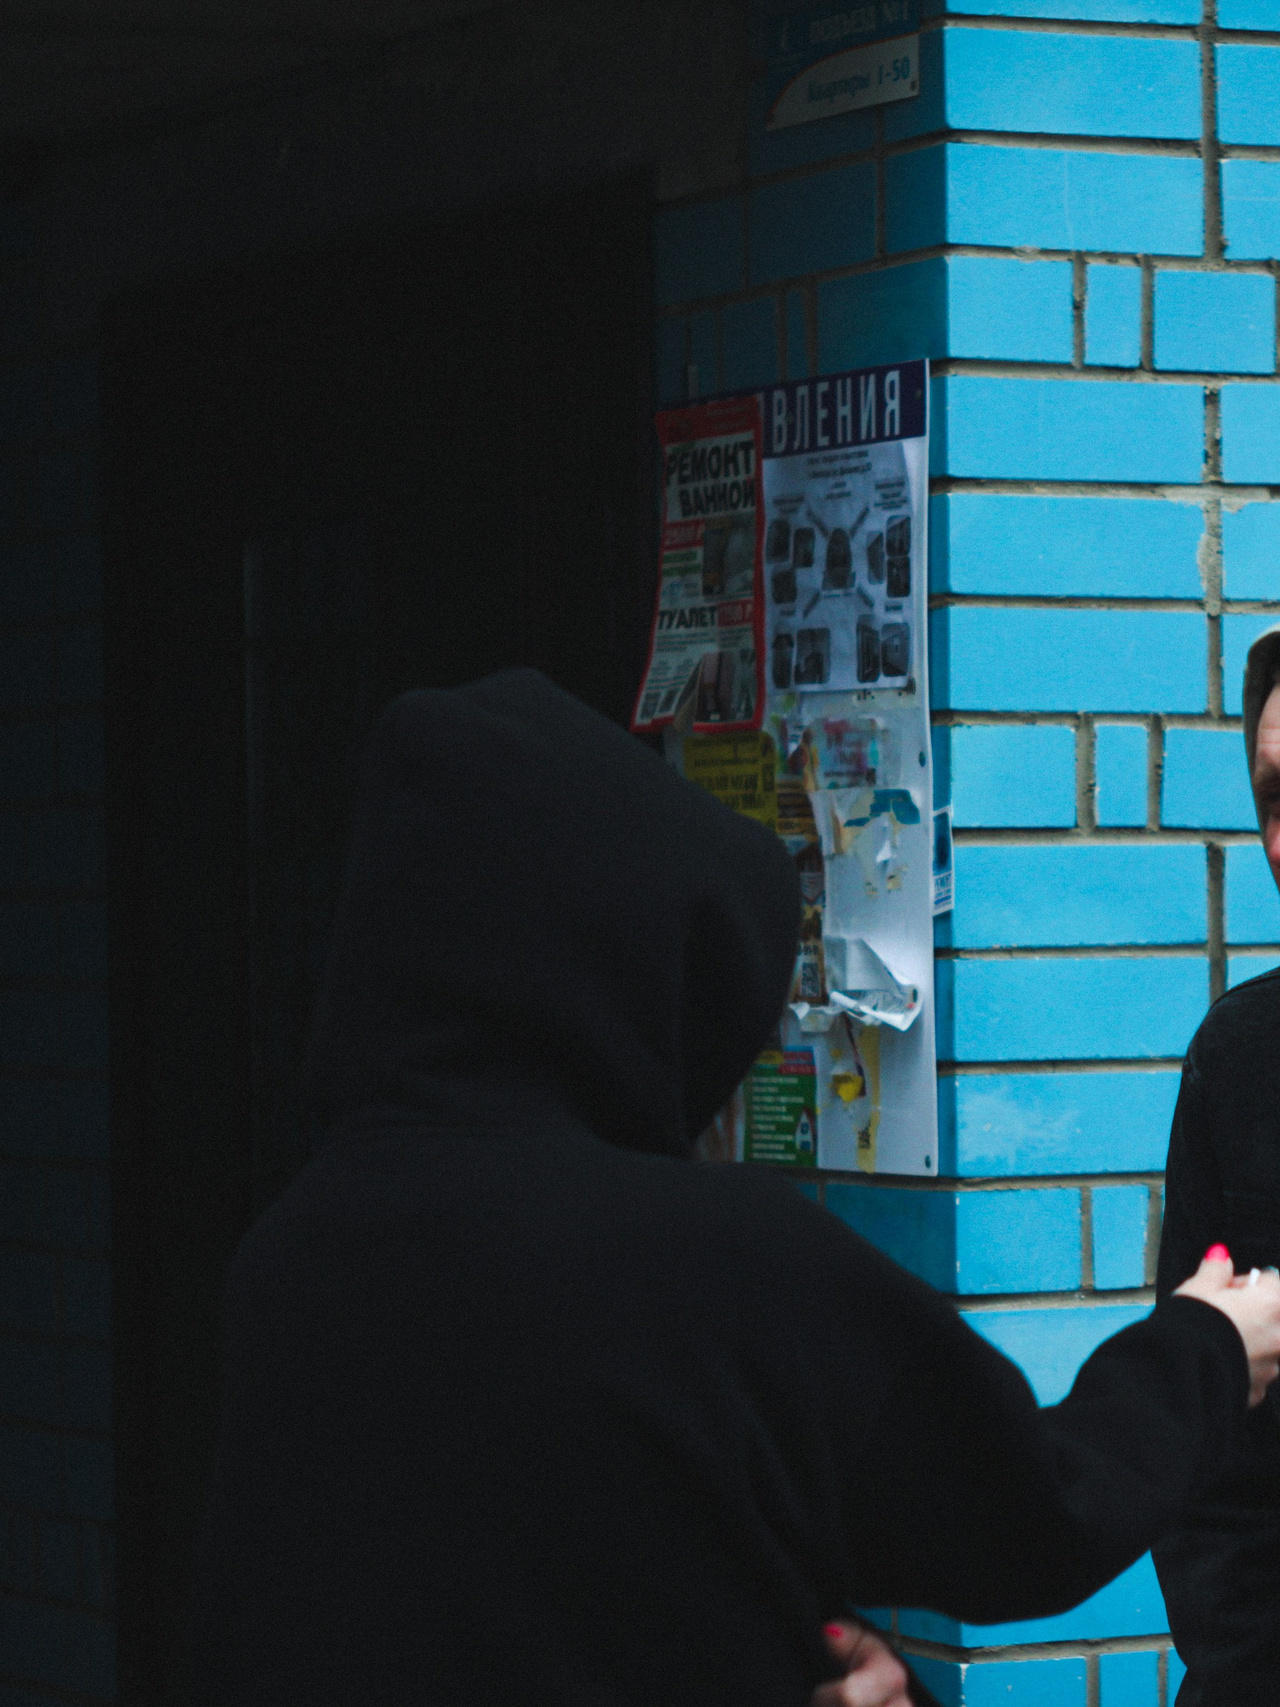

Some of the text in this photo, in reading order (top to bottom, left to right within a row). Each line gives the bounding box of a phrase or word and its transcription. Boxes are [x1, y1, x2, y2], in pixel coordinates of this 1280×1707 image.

[877, 56, 910, 87] 1-50
[757, 368, 902, 455] ВЛЕНИЯ
[665, 440, 755, 485] РЕМОНТ
[679, 478, 756, 517] ВАННОЙ
[658, 605, 717, 631] ТУАЛЕТ
